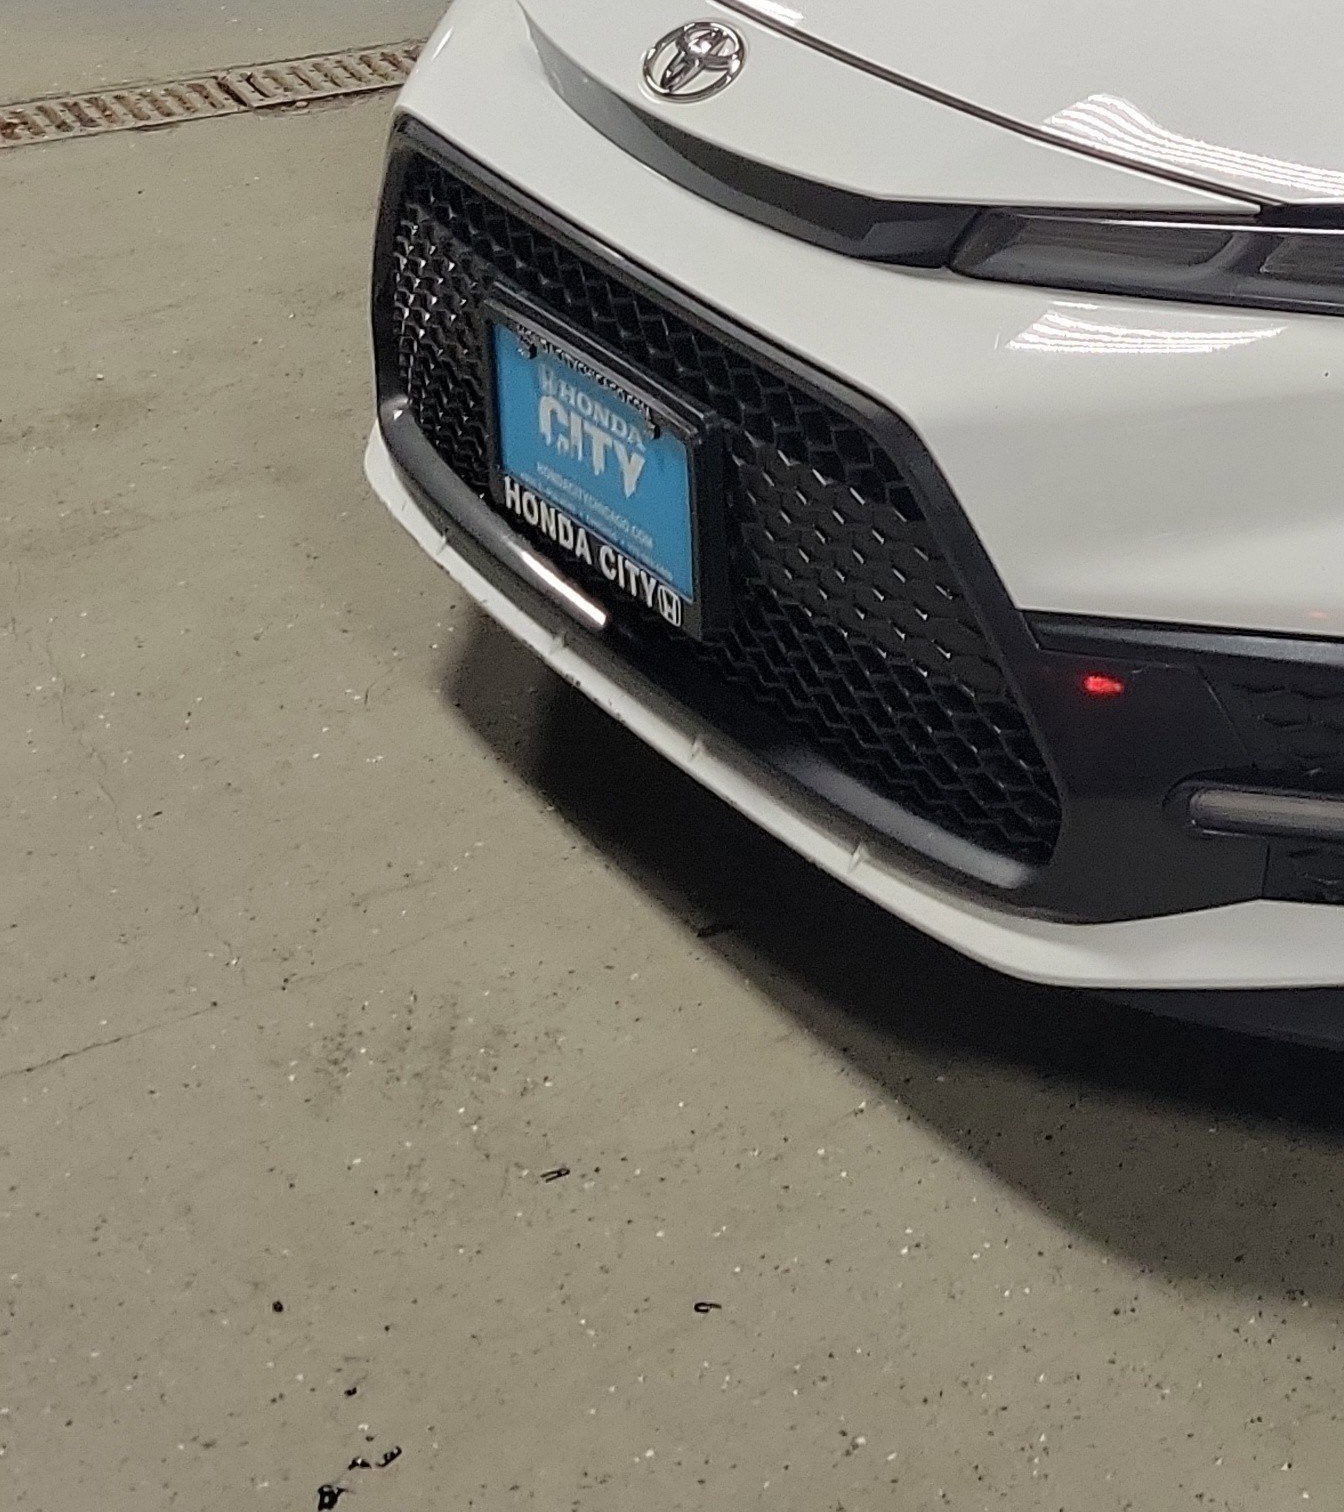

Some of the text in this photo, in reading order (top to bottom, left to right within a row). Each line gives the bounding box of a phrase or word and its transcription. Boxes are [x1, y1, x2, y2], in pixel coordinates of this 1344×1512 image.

[540, 395, 646, 499] CITY
[560, 379, 647, 451] HONDA
[504, 476, 592, 566] HONDA
[600, 545, 659, 609] CITY
